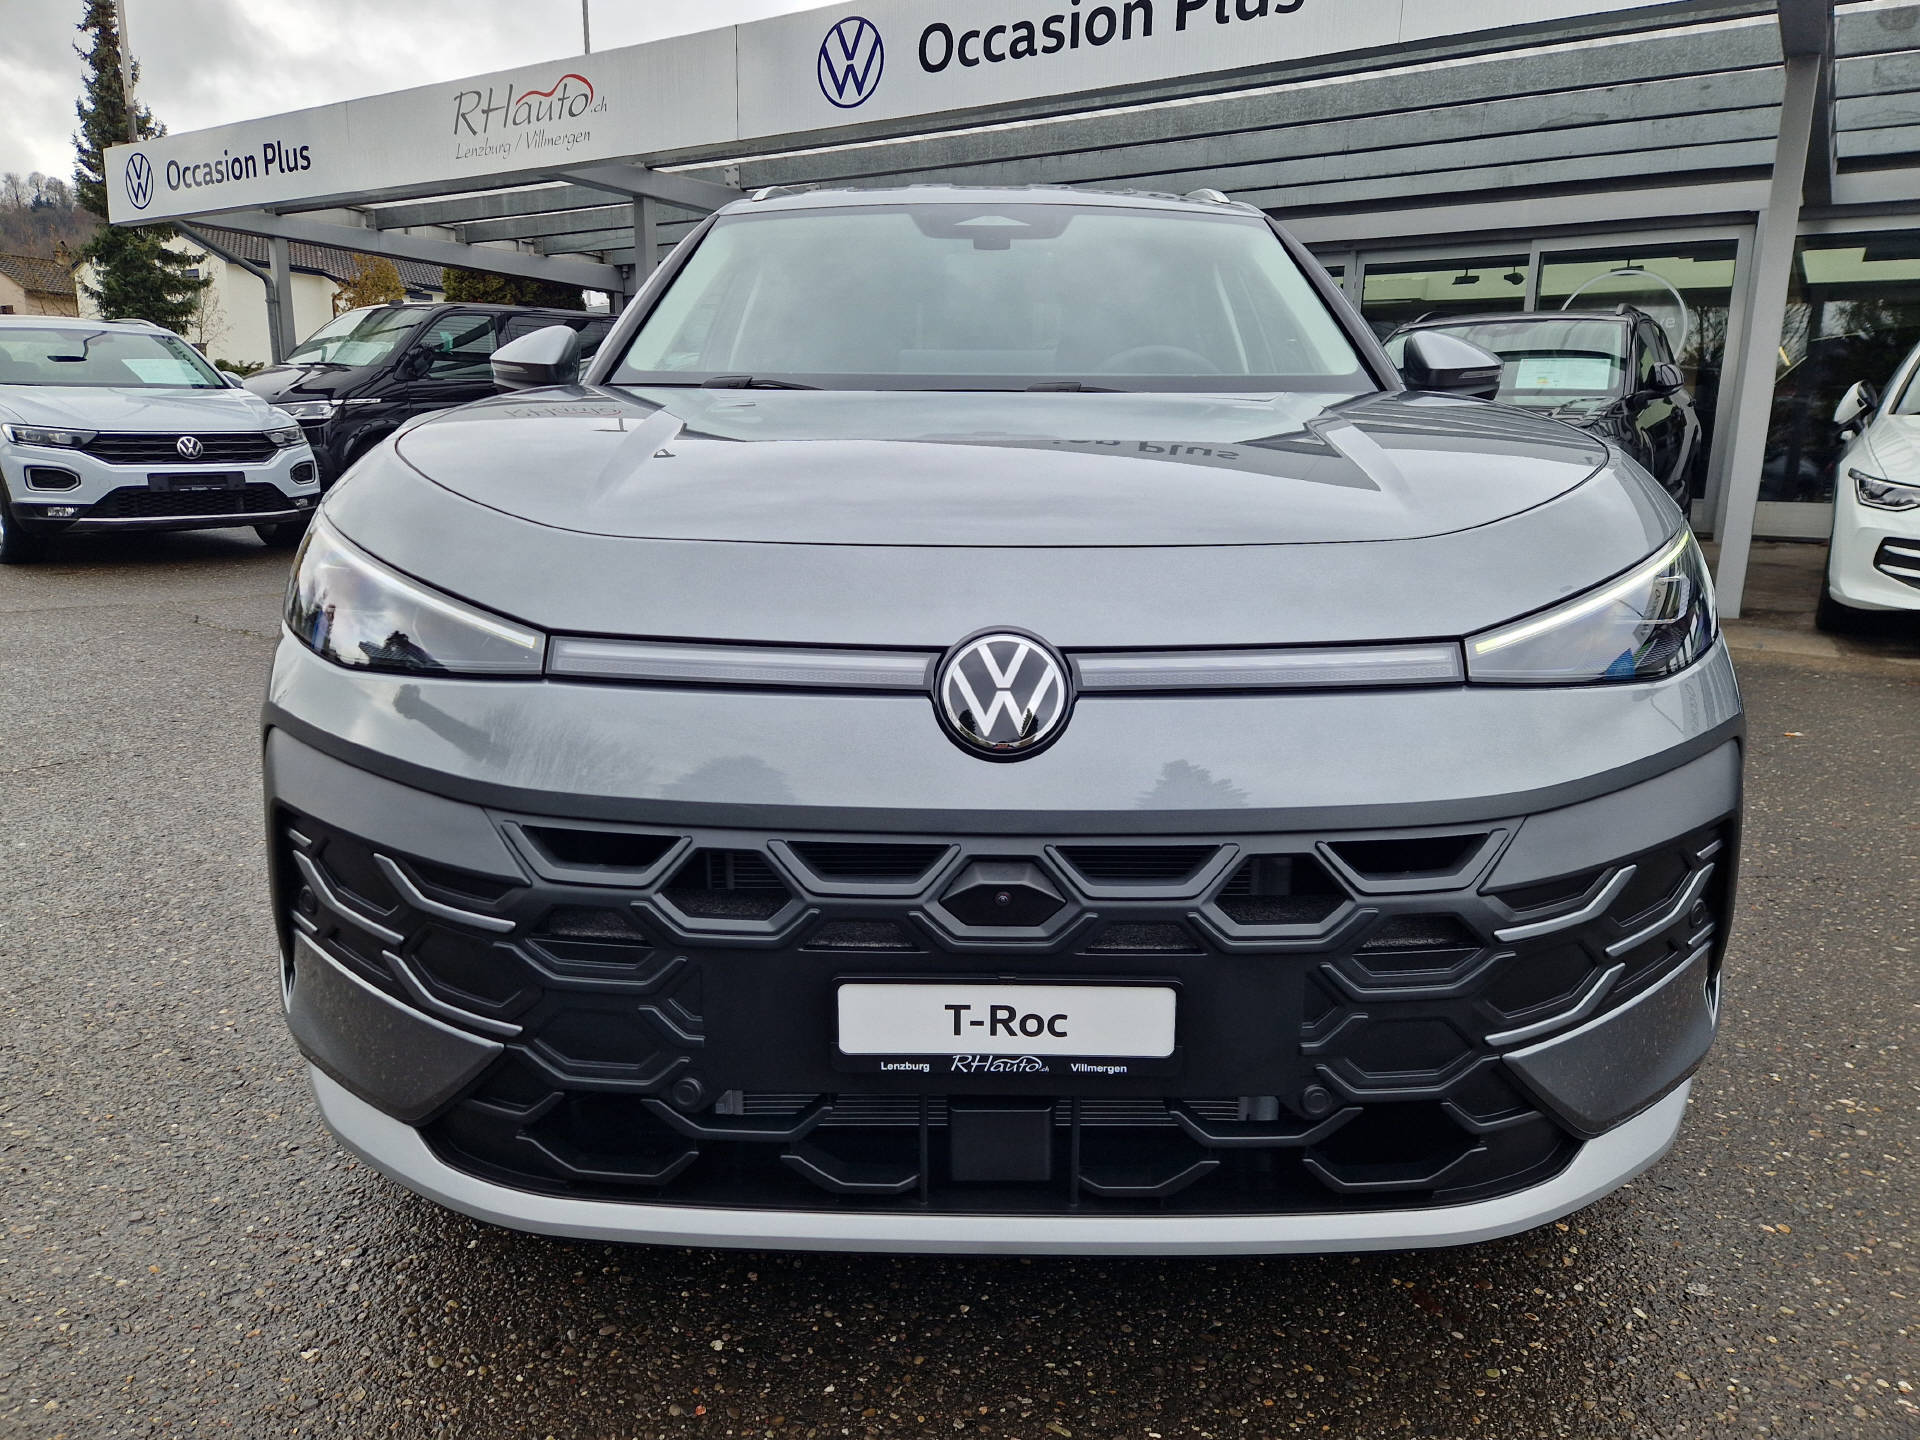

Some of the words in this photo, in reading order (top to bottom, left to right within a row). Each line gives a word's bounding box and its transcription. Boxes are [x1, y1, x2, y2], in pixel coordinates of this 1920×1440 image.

[918, 0, 1153, 73] Occasion
[455, 136, 512, 160] Lenzburg
[526, 129, 592, 151] Villmergen
[166, 149, 257, 192] Occasion
[262, 139, 312, 176] Plus
[943, 1003, 1069, 1038] T-Roc
[879, 1060, 931, 1073] Lenzburg
[1069, 1062, 1128, 1075] Villmergen
